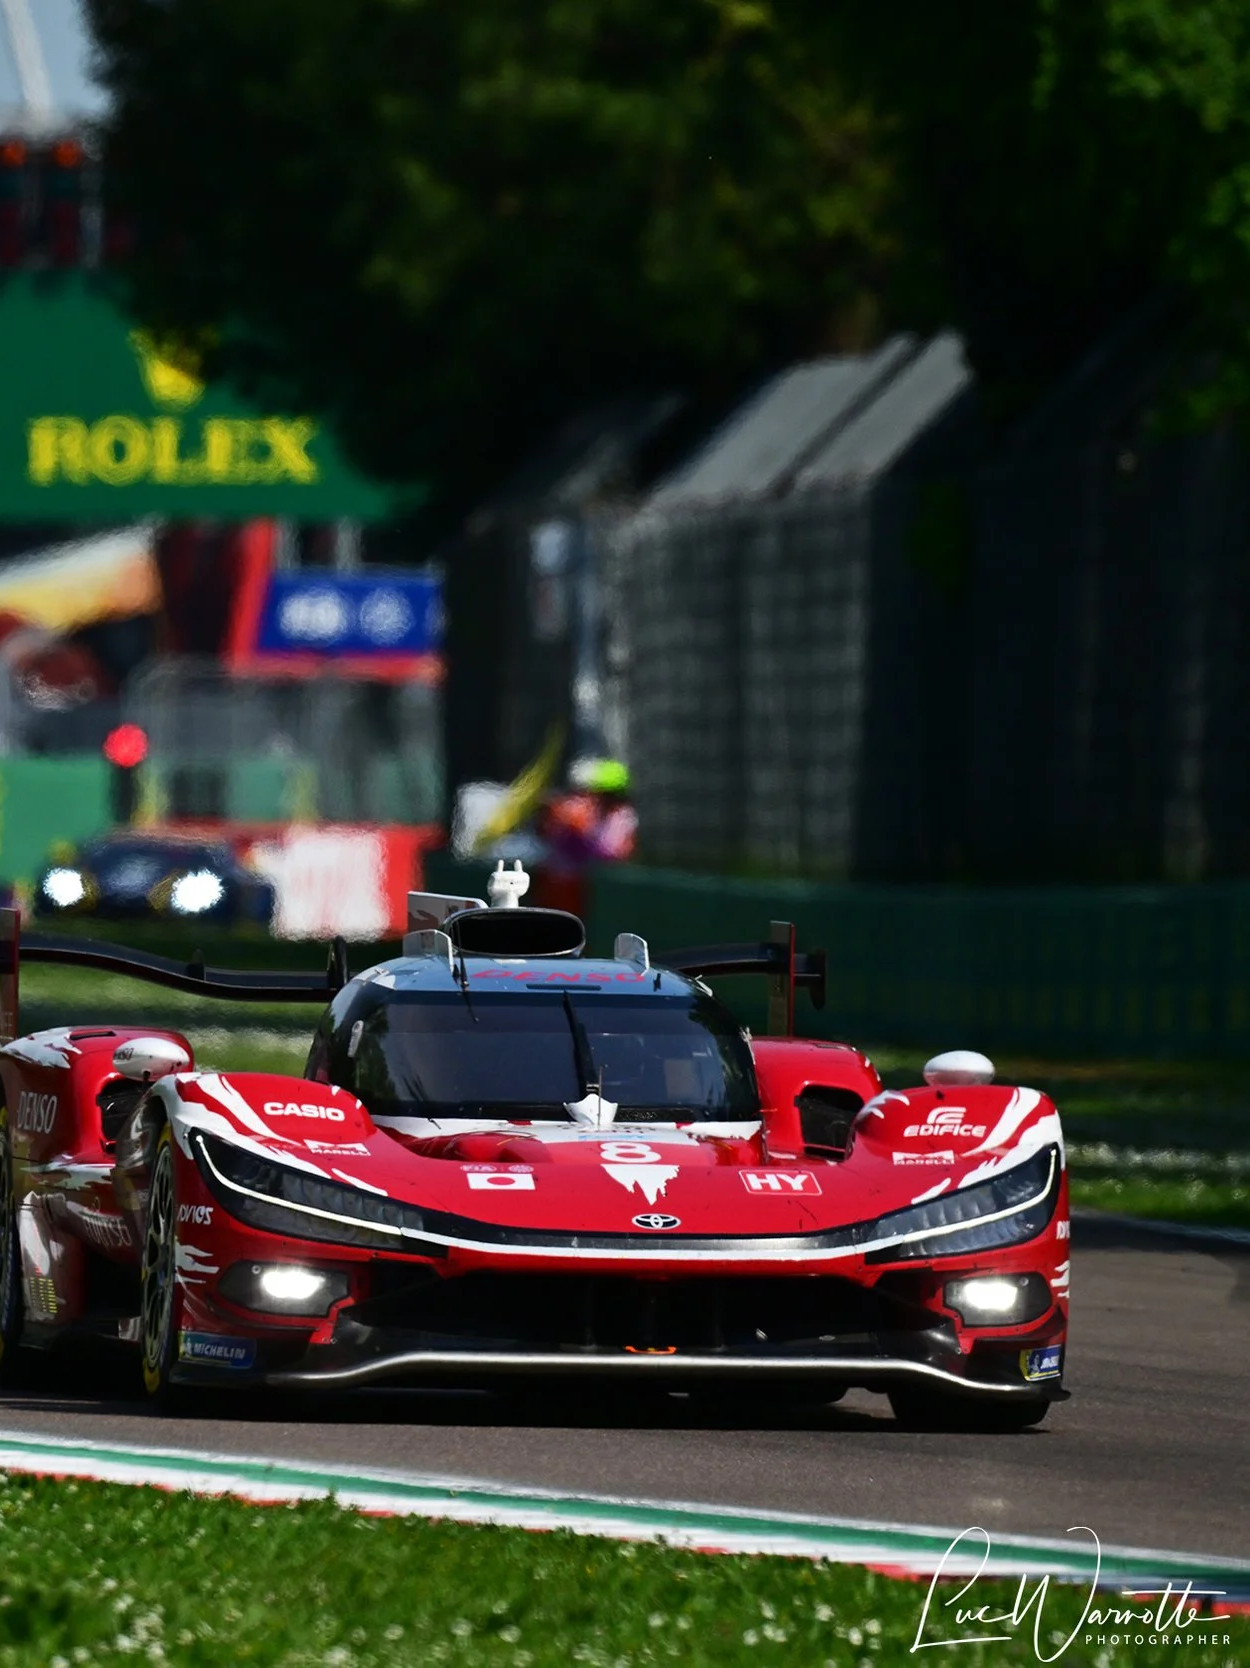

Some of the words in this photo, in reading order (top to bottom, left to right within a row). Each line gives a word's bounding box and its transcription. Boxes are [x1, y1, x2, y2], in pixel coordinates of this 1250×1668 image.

[28, 414, 319, 486] ROLEX
[471, 969, 645, 983] DENSO
[17, 1091, 58, 1135] DENSO
[264, 1102, 345, 1121] CASIO
[903, 1123, 987, 1138] EDIFICE
[600, 1142, 662, 1164] 8
[746, 1173, 810, 1192] HY
[193, 1342, 246, 1360] MICHELIN
